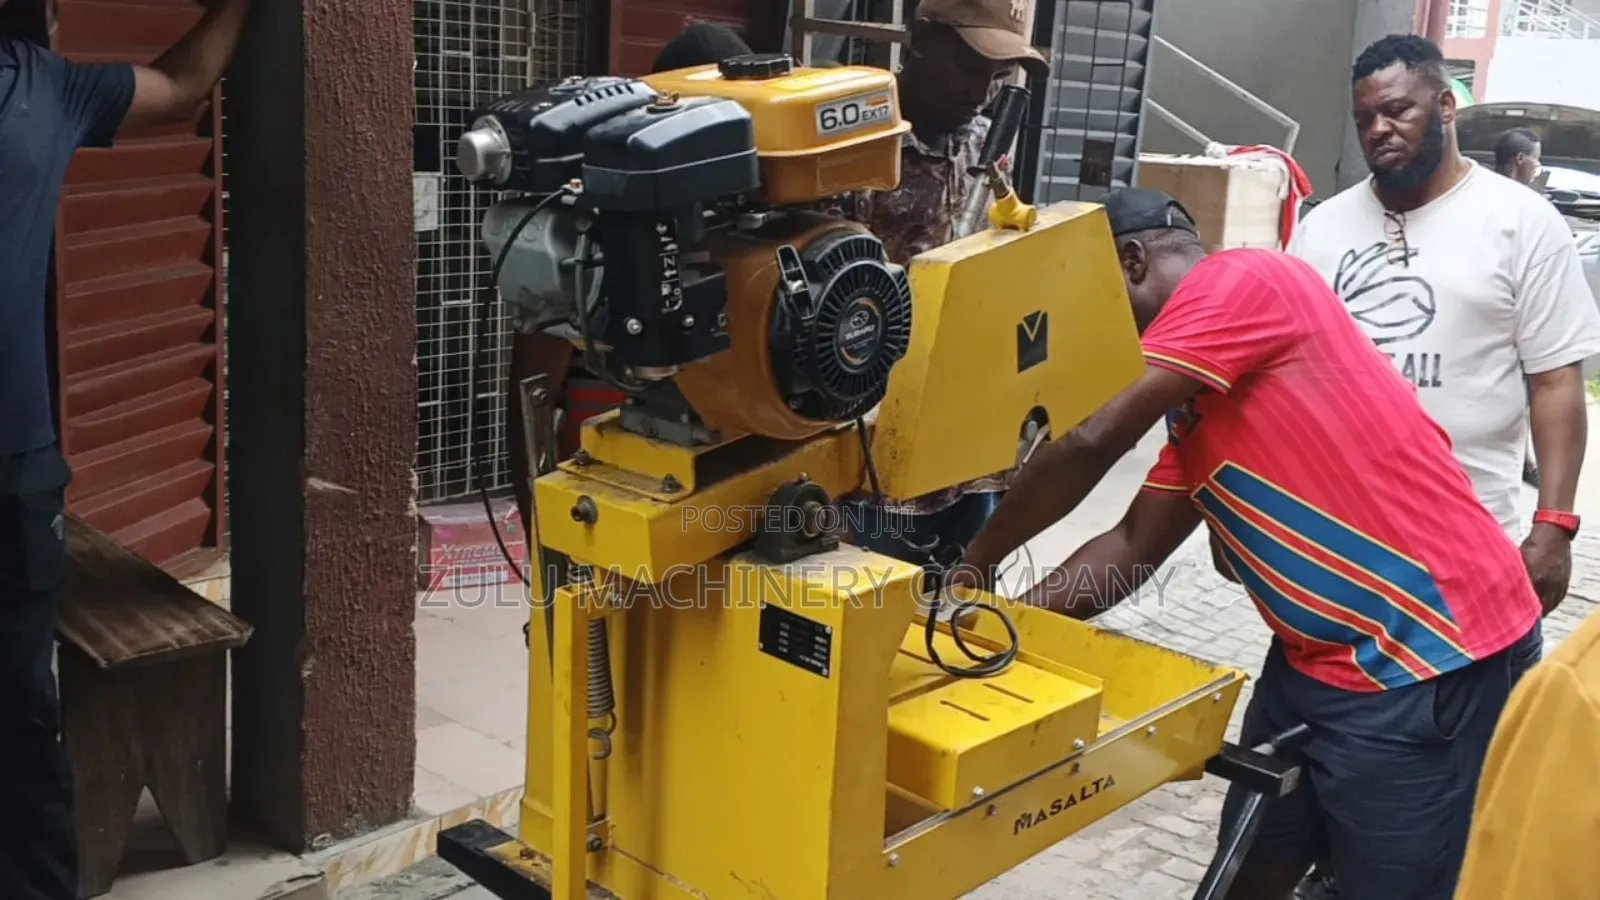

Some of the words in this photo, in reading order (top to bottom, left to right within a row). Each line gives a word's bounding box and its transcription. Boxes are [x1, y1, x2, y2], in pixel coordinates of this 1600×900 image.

[819, 103, 860, 131] 6.0
[861, 105, 889, 121] EX17
[1402, 353, 1443, 388] ALL
[1013, 774, 1117, 836] MASALTA
